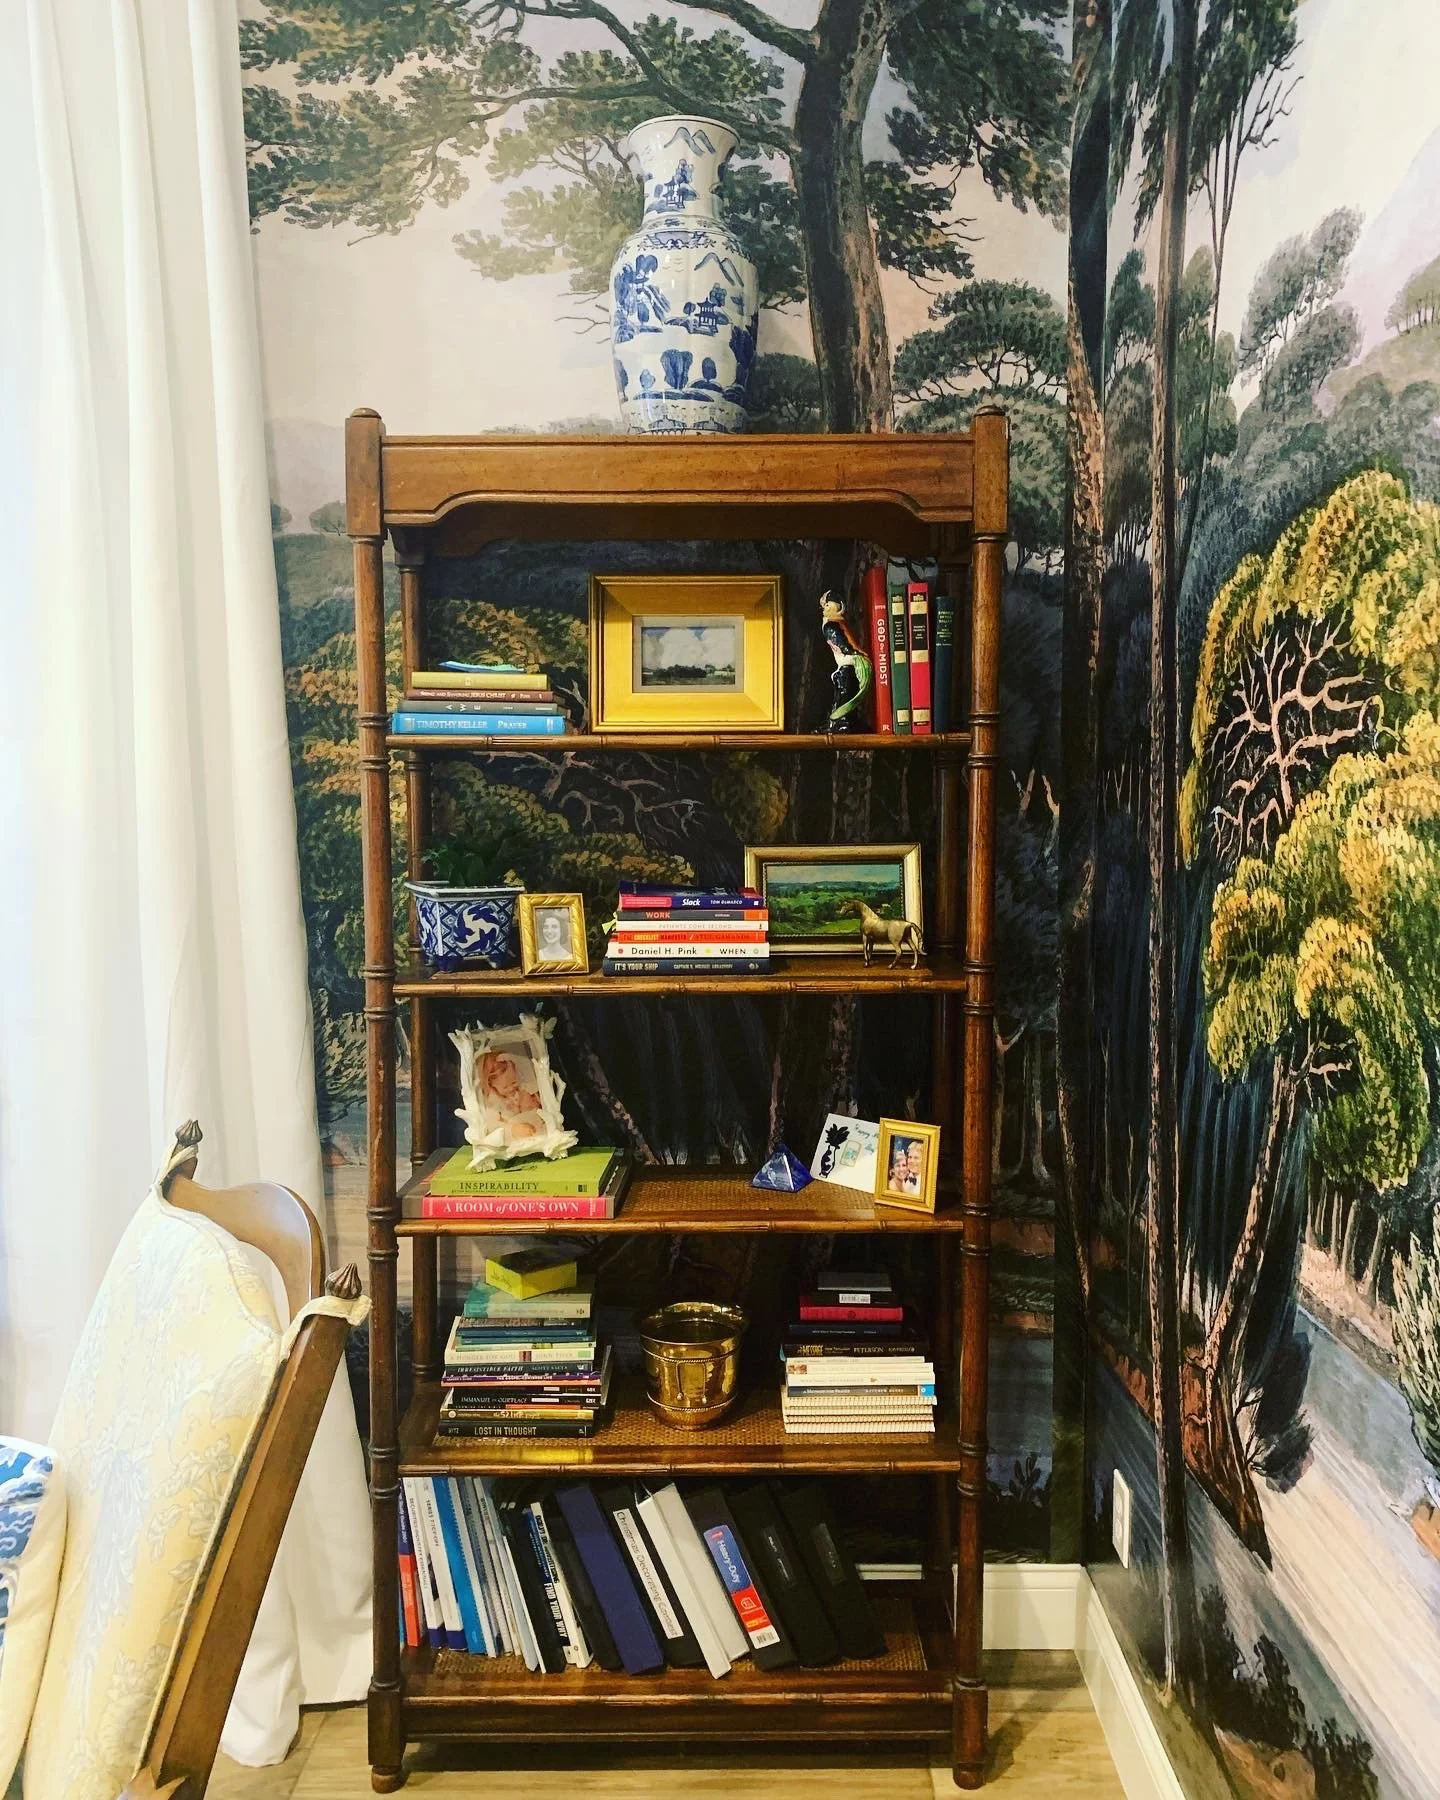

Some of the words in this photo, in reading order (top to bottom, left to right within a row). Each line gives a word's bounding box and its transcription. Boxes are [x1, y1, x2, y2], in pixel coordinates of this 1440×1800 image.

[877, 619, 886, 642] GOD
[879, 654, 888, 686] MIDST
[416, 720, 457, 729] TIMOTHY
[457, 720, 488, 730] KELLER
[682, 898, 701, 906] Slack
[645, 911, 671, 919] WORK
[631, 947, 661, 955] Daniel
[664, 947, 675, 955] H.
[678, 946, 697, 955] Pink
[614, 963, 627, 971] IT'S
[627, 962, 644, 971] YOUR
[644, 962, 659, 971] SHIP
[460, 1182, 540, 1190] INSPIRABILITY
[443, 1203, 451, 1213] A
[455, 1202, 494, 1213] ROOM
[495, 1202, 507, 1214] of
[508, 1201, 546, 1212] ONE'S
[548, 1202, 580, 1213] OWN
[474, 1426, 492, 1435] LOST
[494, 1426, 502, 1435] IN
[504, 1426, 537, 1436] THOUGHT
[426, 1499, 434, 1518] SERIES
[616, 1511, 640, 1555] Christmas
[636, 1552, 661, 1605] Decorating
[717, 1540, 741, 1584] Heavy-Duty
[543, 1582, 557, 1600] FIND
[549, 1600, 564, 1620] YOUR
[555, 1620, 568, 1638] WHY
